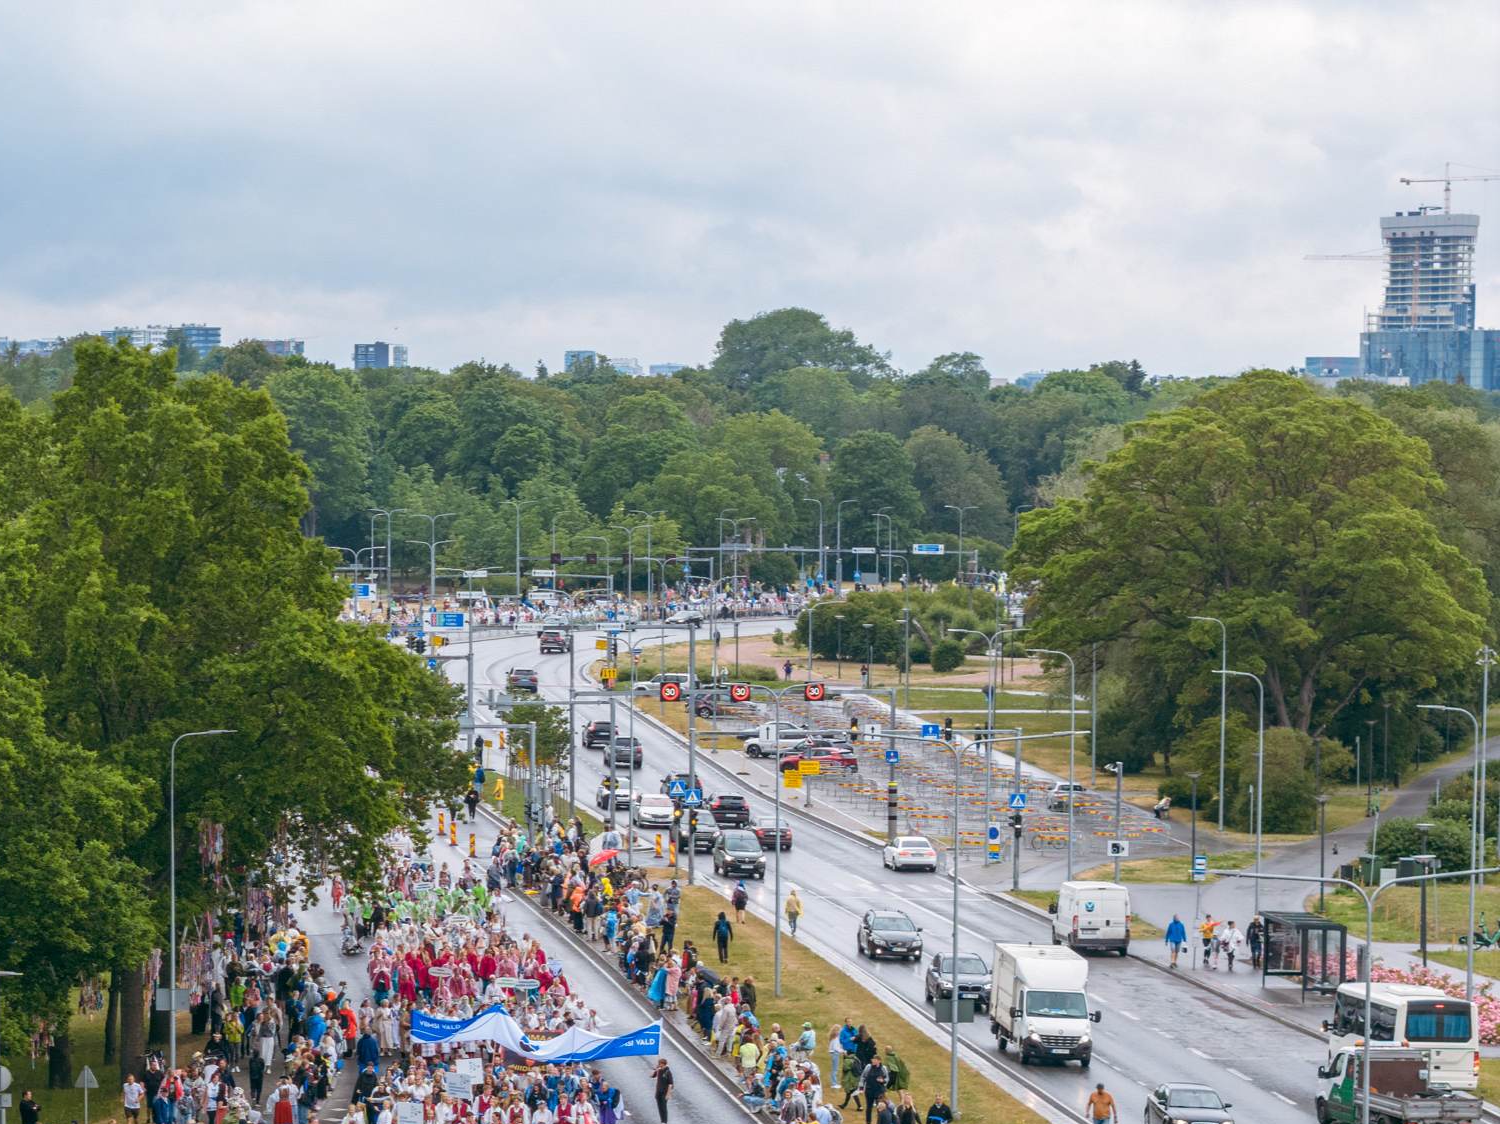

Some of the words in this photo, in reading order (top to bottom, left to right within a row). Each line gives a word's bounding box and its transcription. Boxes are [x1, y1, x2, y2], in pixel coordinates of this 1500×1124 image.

[664, 688, 675, 697] 30
[735, 687, 746, 696] 30
[809, 687, 820, 696] 30
